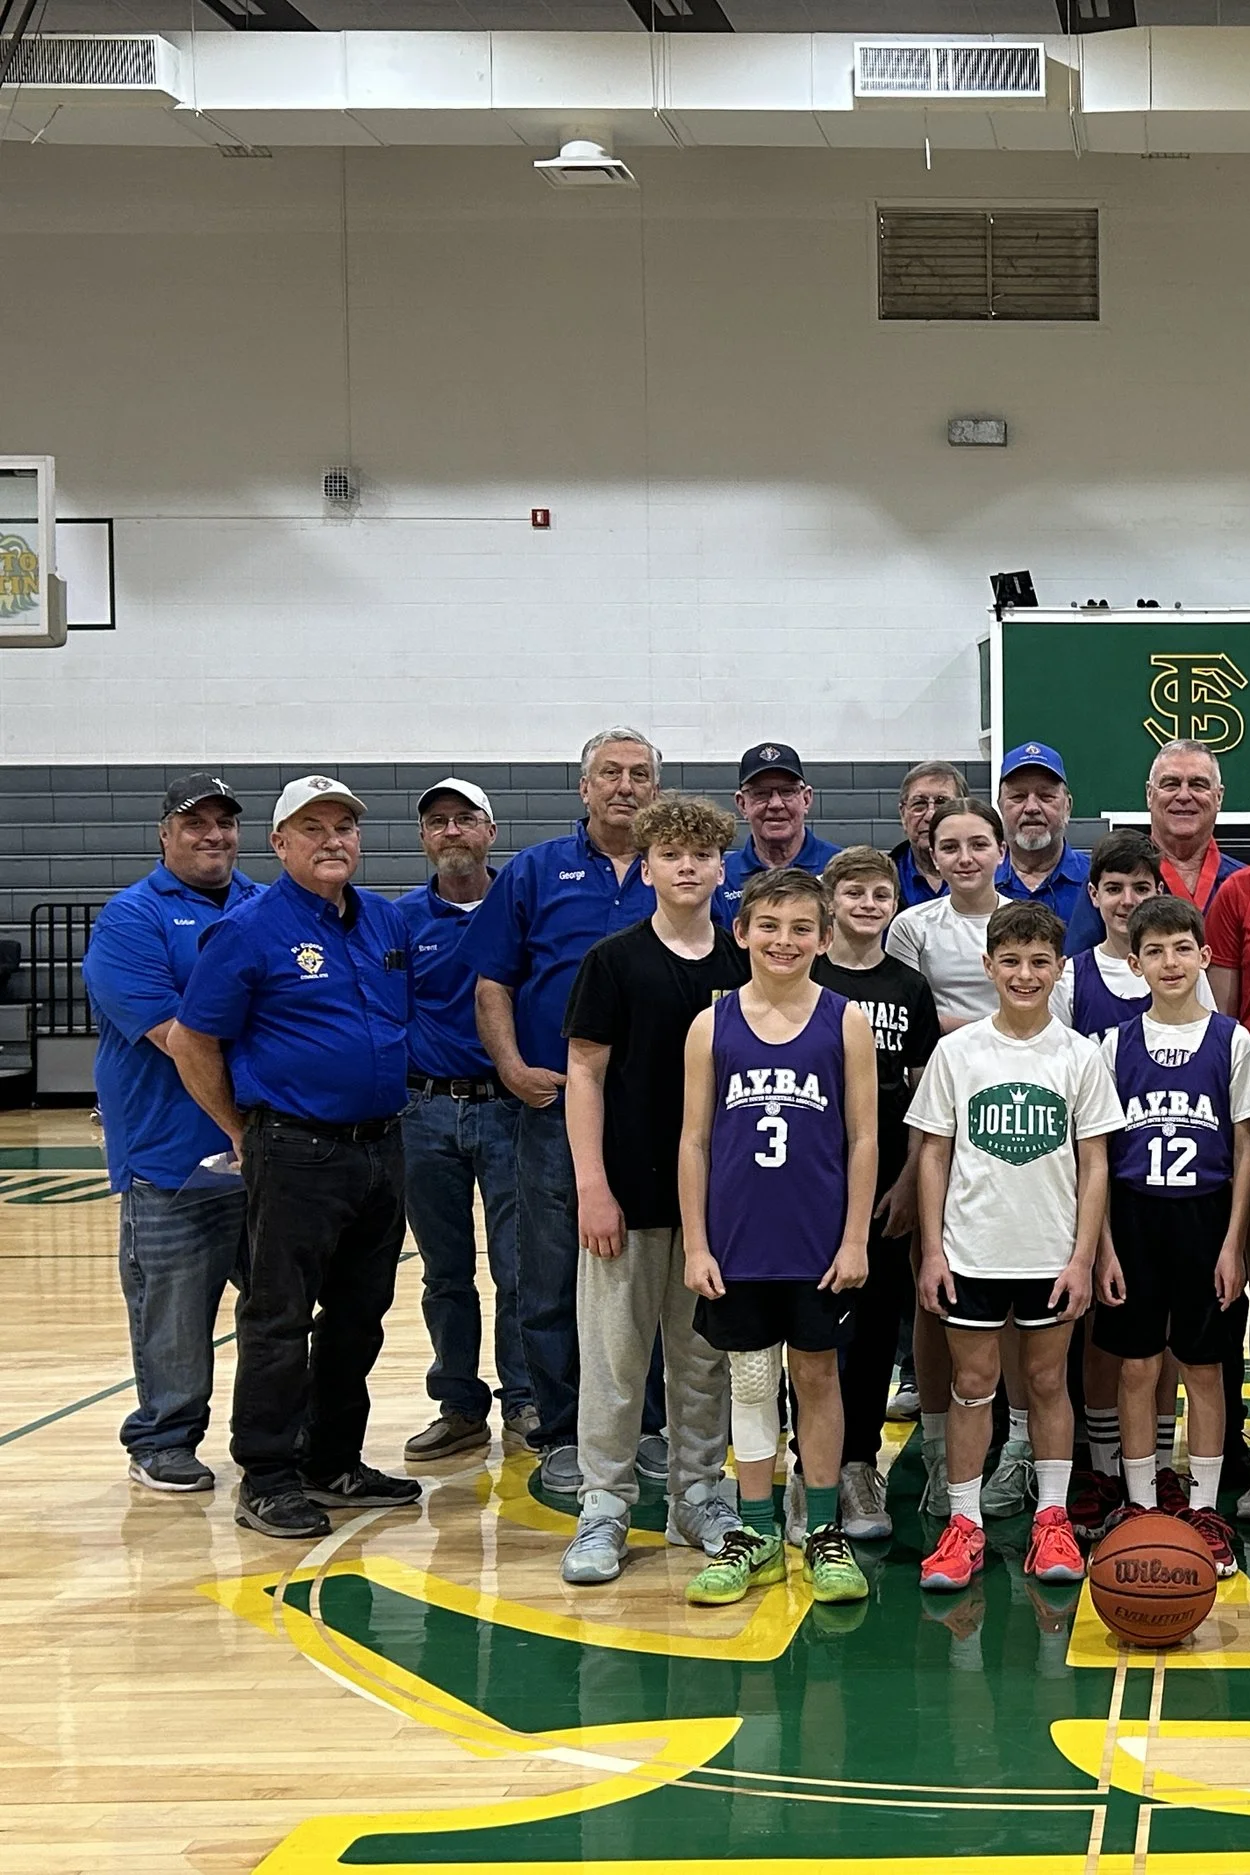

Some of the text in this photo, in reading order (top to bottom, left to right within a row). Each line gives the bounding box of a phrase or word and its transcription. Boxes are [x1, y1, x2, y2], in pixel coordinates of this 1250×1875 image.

[559, 870, 586, 881] George
[977, 1104, 1058, 1136] JOELITE
[754, 1116, 788, 1168] 3
[988, 1139, 1049, 1153] BASKETBALL
[1145, 1136, 1198, 1187] 12
[1114, 1558, 1202, 1587] Wilson
[1114, 1605, 1197, 1624] EVOLUTION
